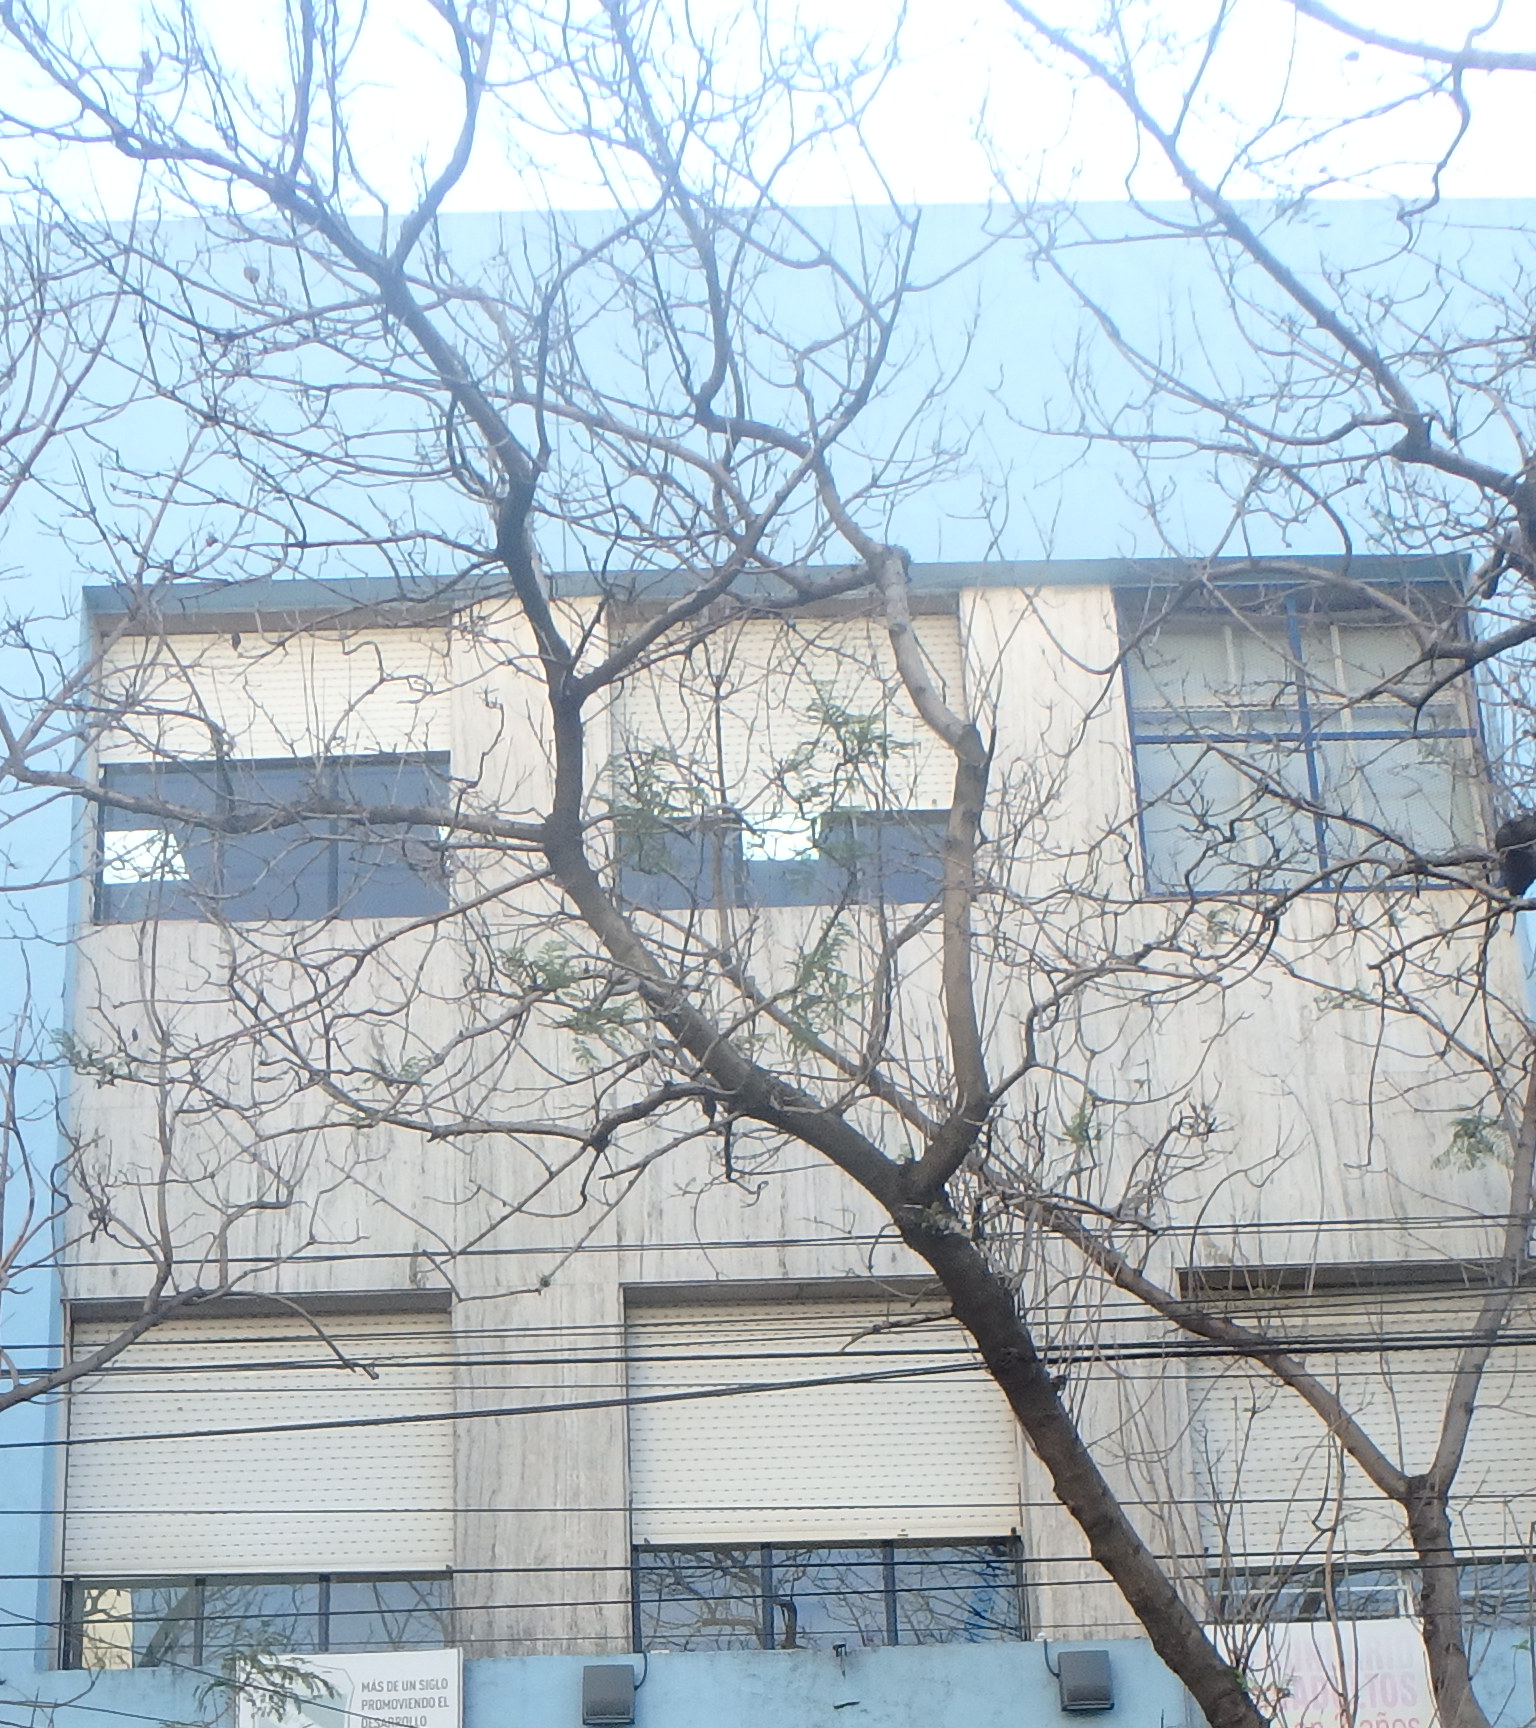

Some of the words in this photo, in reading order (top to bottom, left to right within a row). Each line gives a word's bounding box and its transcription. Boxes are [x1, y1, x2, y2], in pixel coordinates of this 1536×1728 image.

[361, 1678, 384, 1693] MÁS
[386, 1681, 400, 1692] DE
[402, 1680, 416, 1692] UN
[419, 1678, 449, 1690] SIGLO
[361, 1697, 436, 1711] PROMOVIENDO
[438, 1696, 449, 1708] EL
